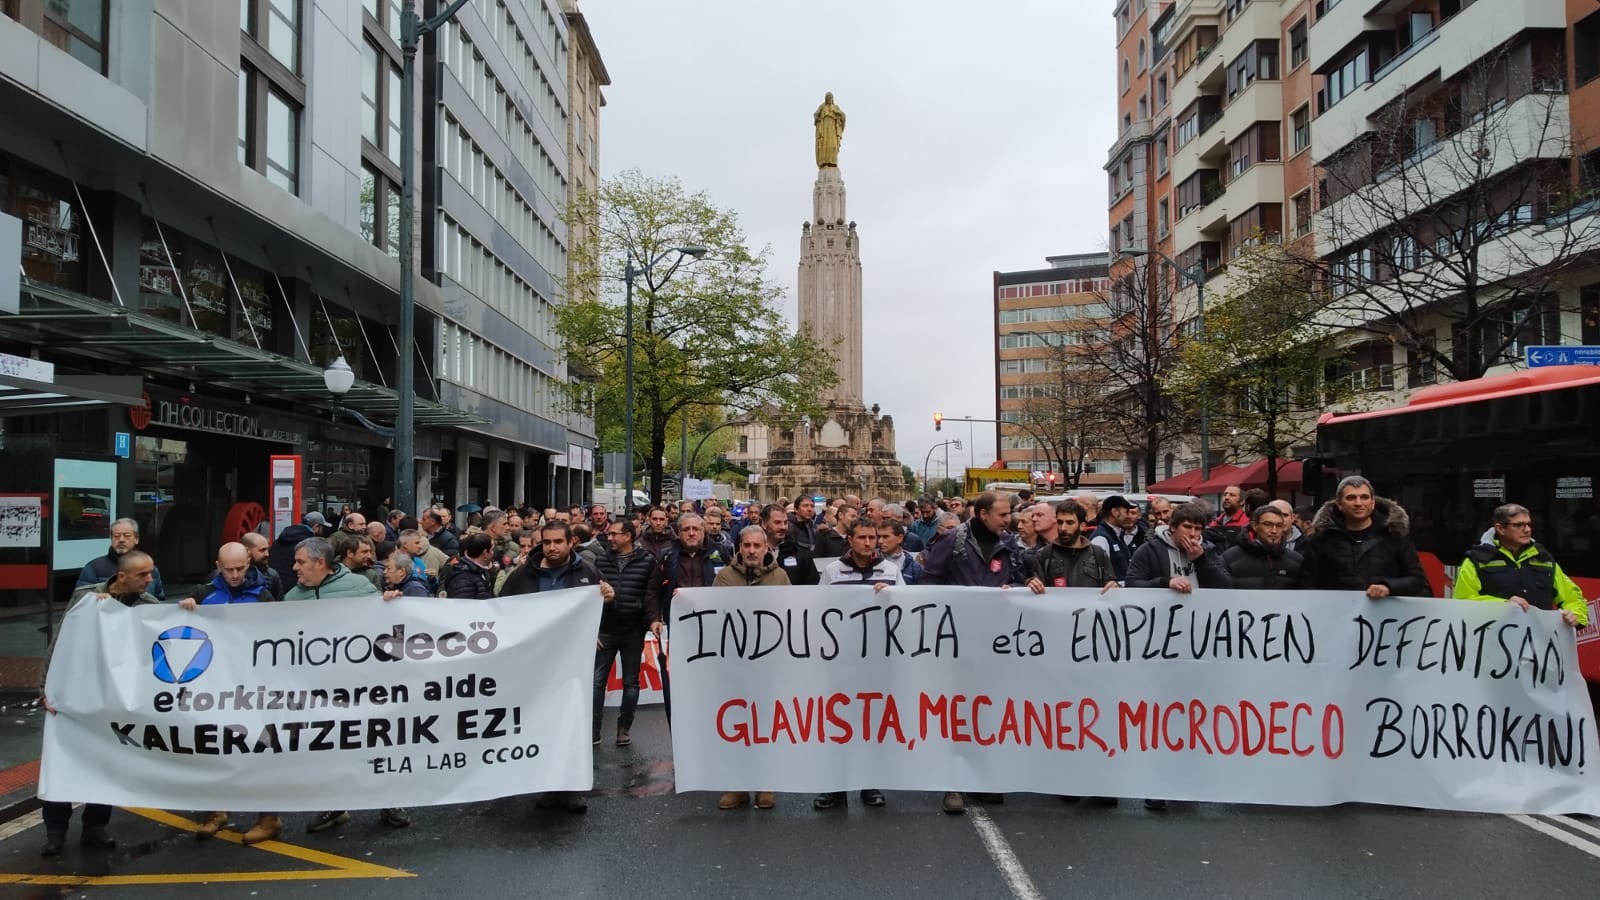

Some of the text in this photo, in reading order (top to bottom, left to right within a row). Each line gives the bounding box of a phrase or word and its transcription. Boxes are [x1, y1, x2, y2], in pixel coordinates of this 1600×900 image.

[181, 405, 258, 435] COLLECTION
[678, 603, 959, 663] INDUSTRIA
[992, 611, 1046, 657] eta
[1348, 614, 1565, 688] DEFENTSAN
[153, 673, 497, 713] etorkizunaren alde
[110, 706, 522, 756] KALERATZERIK EZ!
[1118, 699, 1345, 759] MICRODECO
[1366, 697, 1587, 774] BORROKAN!
[368, 743, 540, 774] ELA LAB CCOO
